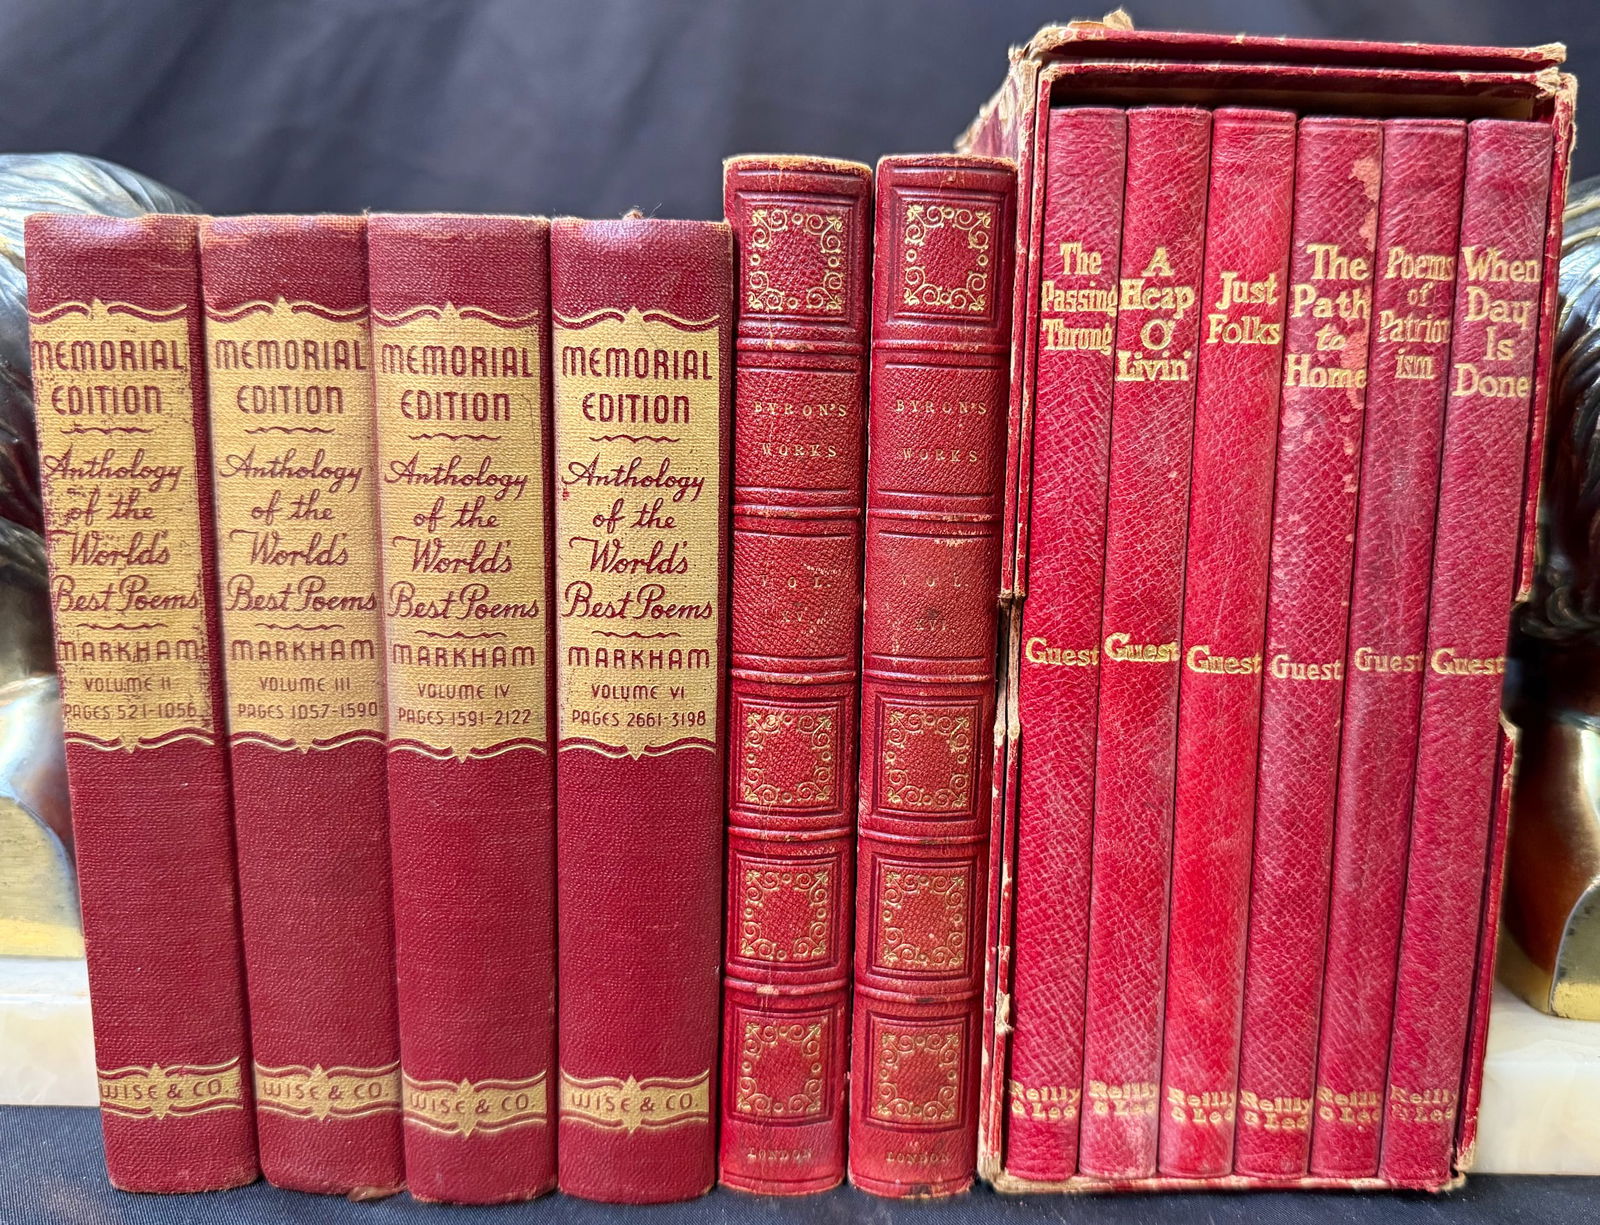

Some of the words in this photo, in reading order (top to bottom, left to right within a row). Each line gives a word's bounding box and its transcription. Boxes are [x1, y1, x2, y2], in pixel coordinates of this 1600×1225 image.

[1060, 242, 1102, 275] The
[1141, 246, 1174, 277] A
[1306, 243, 1370, 281] The
[1384, 246, 1455, 281] Poems
[1461, 247, 1540, 282] When
[1041, 281, 1118, 317] Passing
[1119, 278, 1195, 319] Heap
[1215, 271, 1278, 310] Just
[1290, 283, 1371, 320] Path
[1407, 281, 1437, 307] of
[1465, 286, 1531, 330] Day
[1042, 318, 1114, 355] Throng
[1206, 313, 1281, 345] Folks
[1315, 323, 1347, 351] to
[1483, 325, 1514, 361] Is
[31, 339, 186, 371] MEMORIAL
[215, 339, 367, 371] MEMORIAL
[381, 343, 534, 378] MEMORIAL
[562, 345, 713, 381] MEMORIAL
[1115, 351, 1192, 382] Livin'
[1395, 349, 1437, 379] ism
[1284, 353, 1367, 389] Home
[1452, 362, 1531, 398] Done
[52, 385, 162, 415] EDITION
[237, 384, 344, 414] EDITION
[401, 390, 511, 422] EDITION
[582, 392, 691, 424] EDITION
[753, 402, 847, 417] BYRON'S
[895, 399, 987, 415] BYRON'S
[760, 444, 838, 458] WORKS
[903, 447, 978, 463] WORKS
[43, 443, 184, 493] Anthology
[218, 446, 363, 493] Anthology
[384, 450, 528, 500] Anthology
[561, 451, 705, 503] Anthology
[66, 484, 101, 526] of
[107, 488, 157, 520] the
[250, 490, 284, 525] of
[287, 488, 335, 520] the
[413, 496, 447, 533] of
[450, 495, 499, 528] the
[592, 497, 626, 534] of
[630, 497, 677, 529] the
[52, 574, 117, 612] Best
[116, 574, 200, 612] Poems
[225, 573, 296, 612] Best
[295, 574, 377, 612] Poems
[387, 580, 459, 620] Best
[455, 583, 539, 620] Poems
[561, 580, 635, 619] Best
[631, 583, 713, 620] Poems
[58, 640, 200, 663] MARKHAM
[231, 639, 375, 661] MARKHAM
[392, 644, 536, 668] MARKHAM
[568, 645, 710, 670] MARKHAM
[1025, 637, 1100, 666] Guest
[1104, 632, 1181, 662] Guest
[1186, 645, 1262, 675] Guest
[1354, 646, 1424, 673] Guest
[1431, 648, 1506, 675] Guest
[1270, 654, 1344, 681] Guest
[84, 677, 151, 693] VOLUME
[161, 677, 172, 692] II
[259, 676, 326, 692] VOLUME
[334, 676, 352, 691] III
[417, 683, 484, 700] VOLUME
[494, 684, 510, 699] IV
[591, 683, 658, 701] VOLUME
[670, 686, 685, 700] VI
[64, 704, 111, 721] PAGES
[117, 703, 198, 721] 521-1056
[238, 704, 284, 720] PAGES
[290, 701, 378, 720] 1057-1590
[398, 708, 445, 726] PAGES
[451, 708, 532, 727] 1591-2122
[572, 710, 619, 728] PAGES
[626, 709, 707, 728] 2661-3198
[101, 1082, 158, 1100] WISE
[167, 1084, 183, 1099] &
[193, 1078, 230, 1097] CO.
[263, 1080, 320, 1100] WISE
[328, 1085, 344, 1100] &
[353, 1082, 390, 1100] CO.
[409, 1092, 466, 1114] WISE
[475, 1098, 490, 1114] &
[501, 1092, 537, 1110] CO.
[571, 1092, 631, 1112] WISE
[639, 1096, 655, 1113] &
[666, 1092, 699, 1110] CO.
[1009, 1080, 1080, 1103] Reilly
[1240, 1090, 1312, 1114] Reilly
